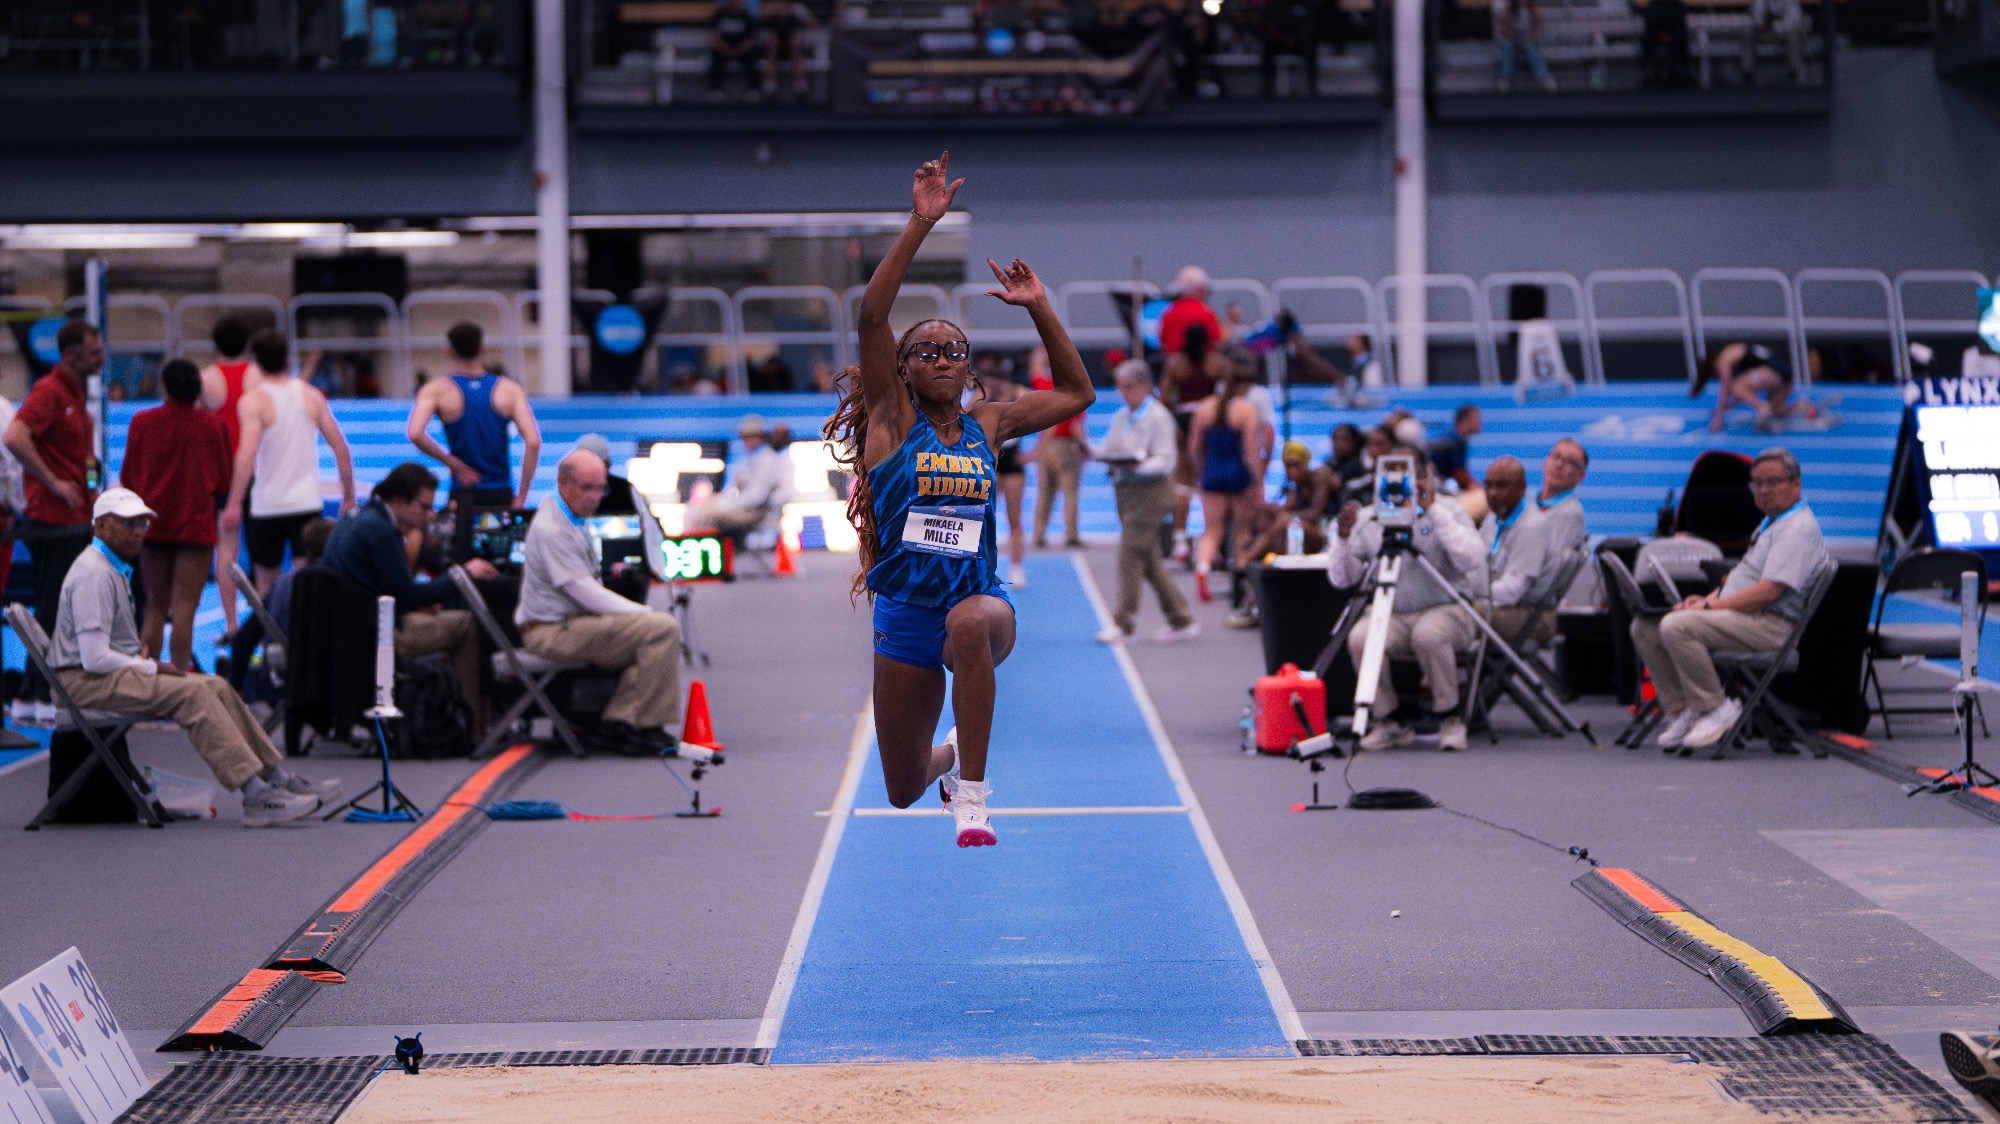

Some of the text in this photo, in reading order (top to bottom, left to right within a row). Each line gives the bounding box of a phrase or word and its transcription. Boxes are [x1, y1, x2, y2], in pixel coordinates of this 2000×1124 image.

[1924, 377, 2000, 406] LYNX
[918, 477, 992, 500] RIDDLE
[924, 518, 964, 532] MIKAELA
[924, 529, 959, 546] MILES
[31, 959, 118, 1061] 40 38
